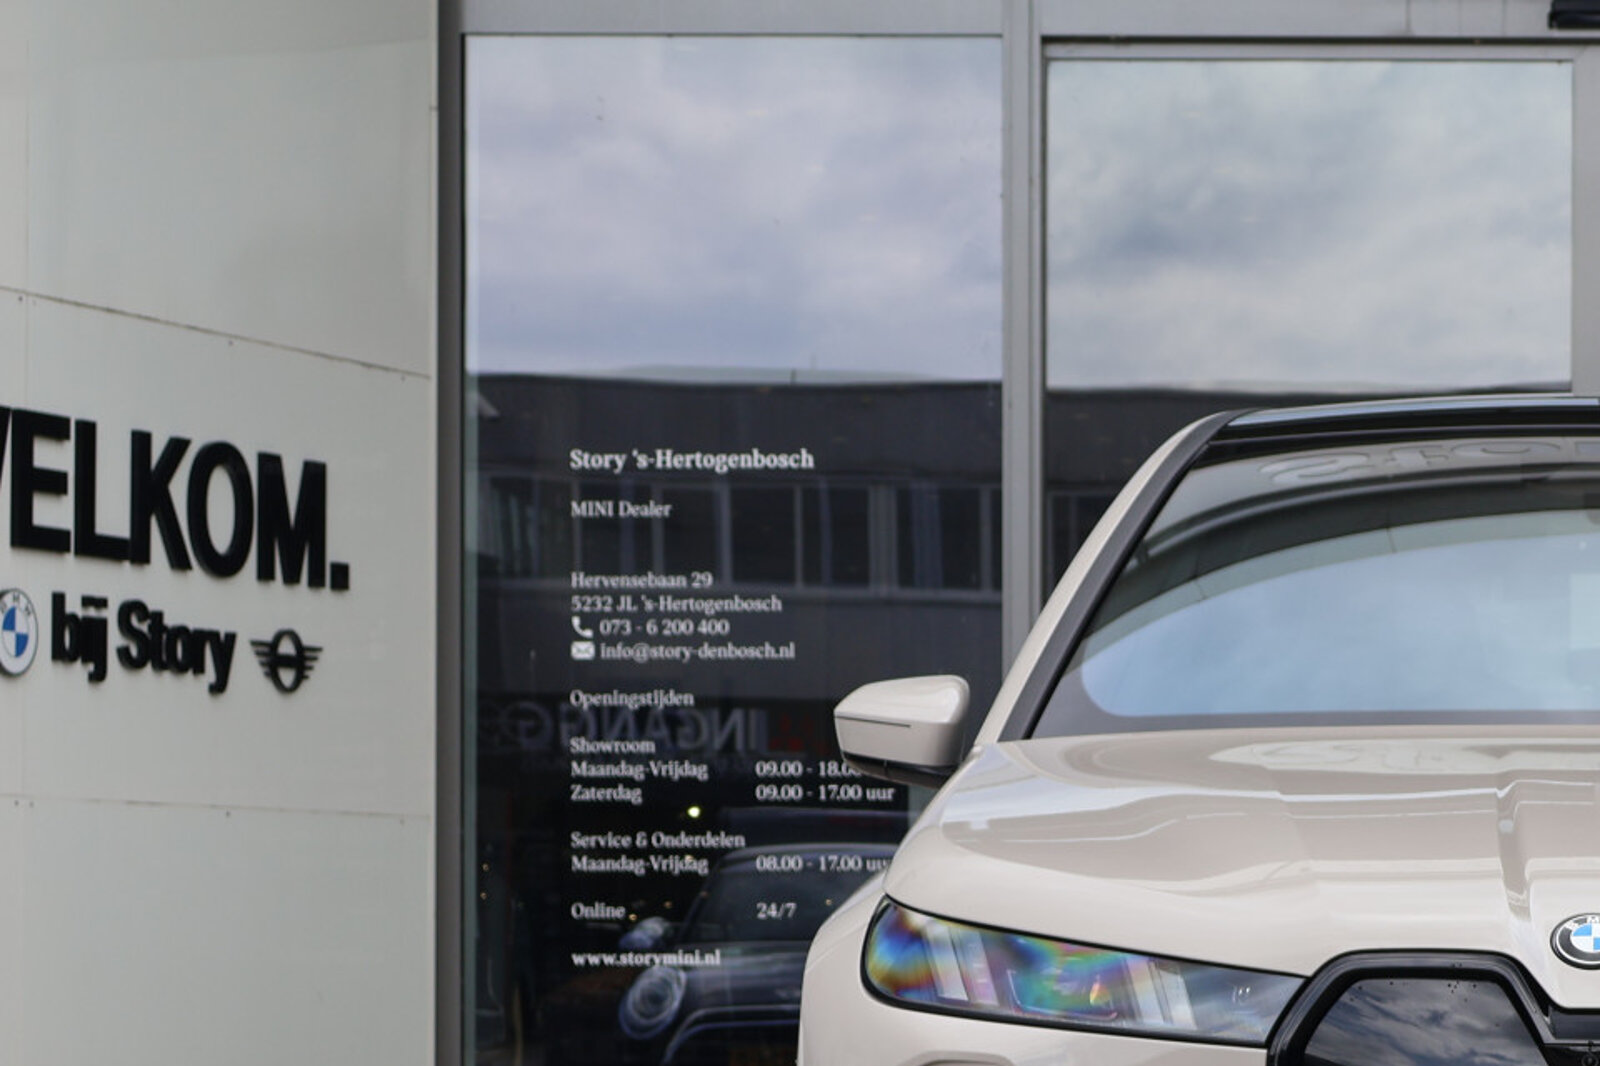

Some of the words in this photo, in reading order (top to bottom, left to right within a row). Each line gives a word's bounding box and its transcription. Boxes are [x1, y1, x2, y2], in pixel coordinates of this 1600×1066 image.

[570, 449, 627, 474] Story
[632, 448, 814, 474] 's-Hertogenbosch
[571, 500, 613, 518] MINI
[619, 500, 672, 518] Dealer
[571, 571, 687, 588] Hervensebaan
[691, 571, 713, 588] 29
[572, 595, 613, 612] 5232
[616, 595, 638, 613] JL
[600, 619, 632, 636] 073
[646, 619, 658, 636] 6
[662, 619, 694, 636] 200
[697, 619, 730, 636] 400
[51, 591, 108, 683] bij
[117, 599, 237, 695] Story
[600, 642, 796, 662] info@story-denbosch.nl
[570, 689, 694, 711] Openingstijden
[570, 737, 655, 754] Showroom
[571, 760, 709, 781] Maandag-Vrijdag
[755, 760, 803, 777] 09.00
[571, 784, 642, 805] Zaterdag
[755, 784, 803, 801] 09.00
[819, 784, 863, 801] 17.00
[866, 787, 896, 801] uur
[571, 831, 632, 848] Service
[635, 831, 648, 848] &
[651, 831, 746, 848] Onderdelen
[572, 855, 709, 877] Maandag-Vrijdag
[755, 855, 803, 871] 08.00
[820, 855, 863, 871] 17.00
[571, 902, 626, 919] Online
[757, 902, 796, 919] 24/7
[572, 950, 721, 969] www.storymini.nl
